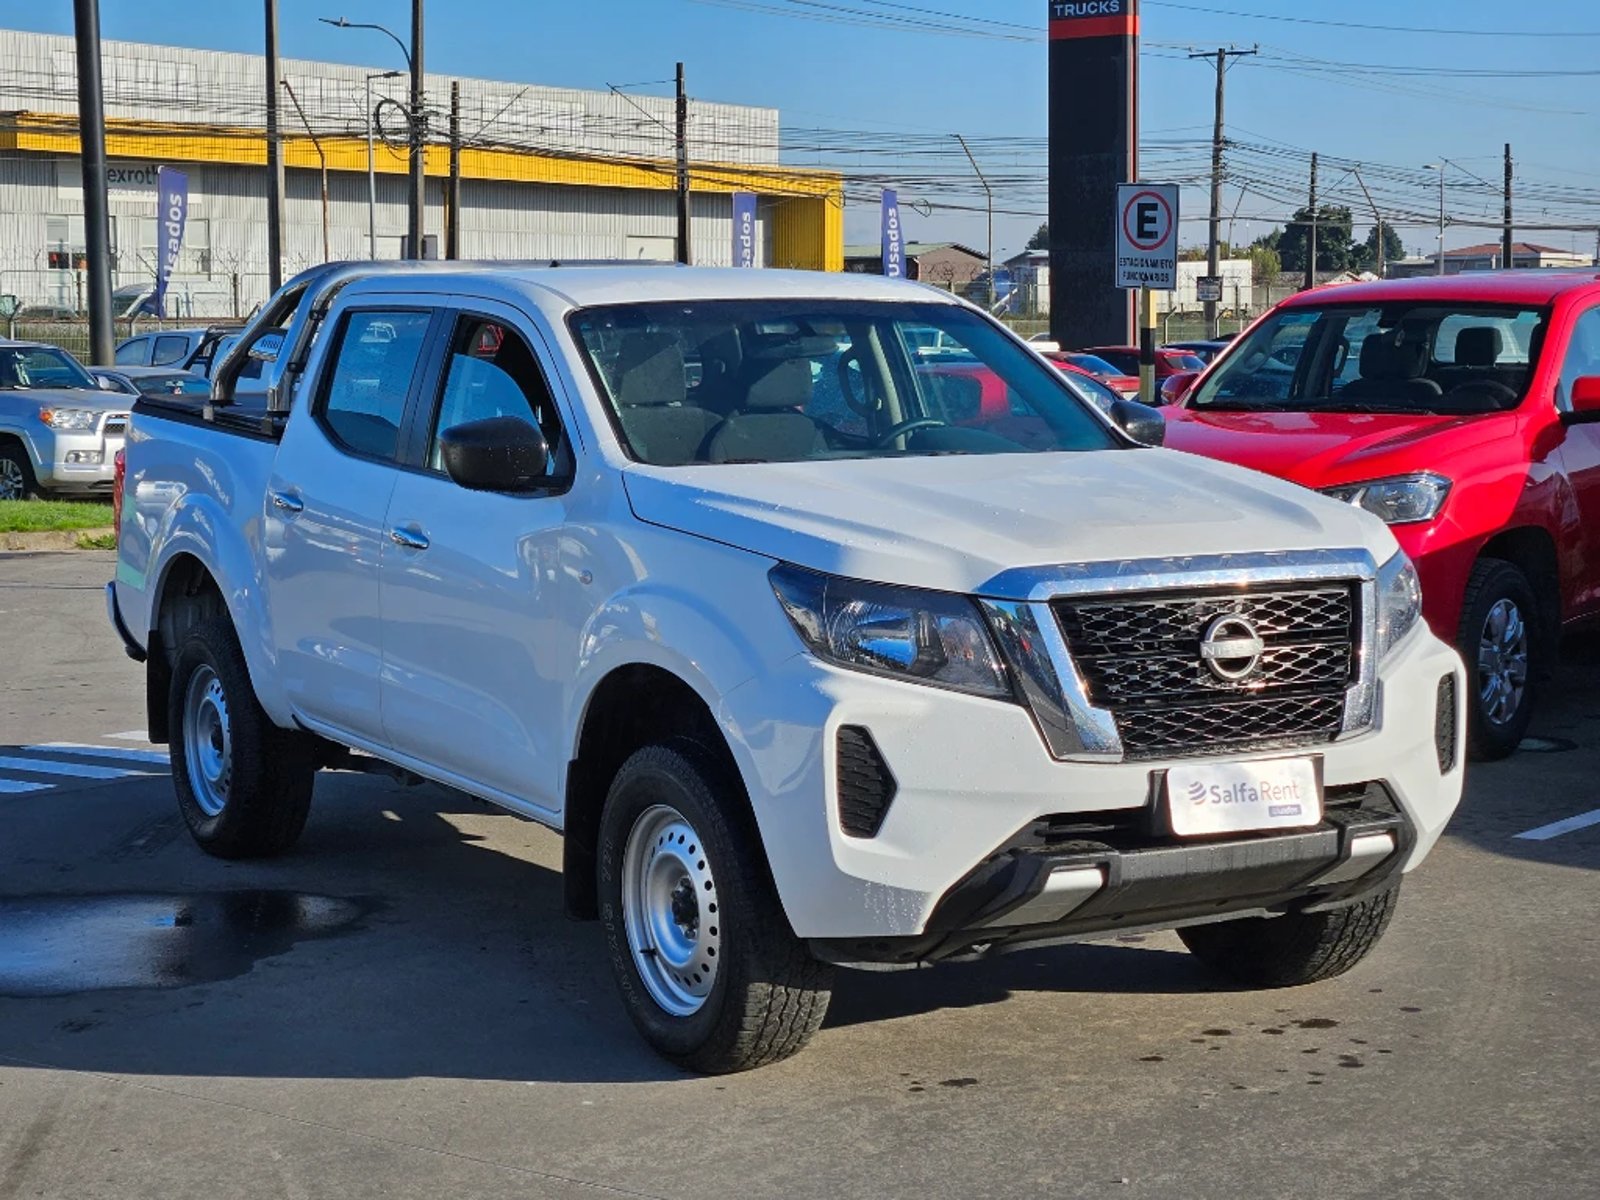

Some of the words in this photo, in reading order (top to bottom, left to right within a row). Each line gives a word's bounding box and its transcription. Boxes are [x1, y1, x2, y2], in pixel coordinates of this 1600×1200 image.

[1054, 0, 1120, 16] TRUCKS
[107, 165, 159, 184] exrot
[1137, 203, 1159, 239] E
[740, 211, 751, 269] sados
[887, 207, 900, 277] usados
